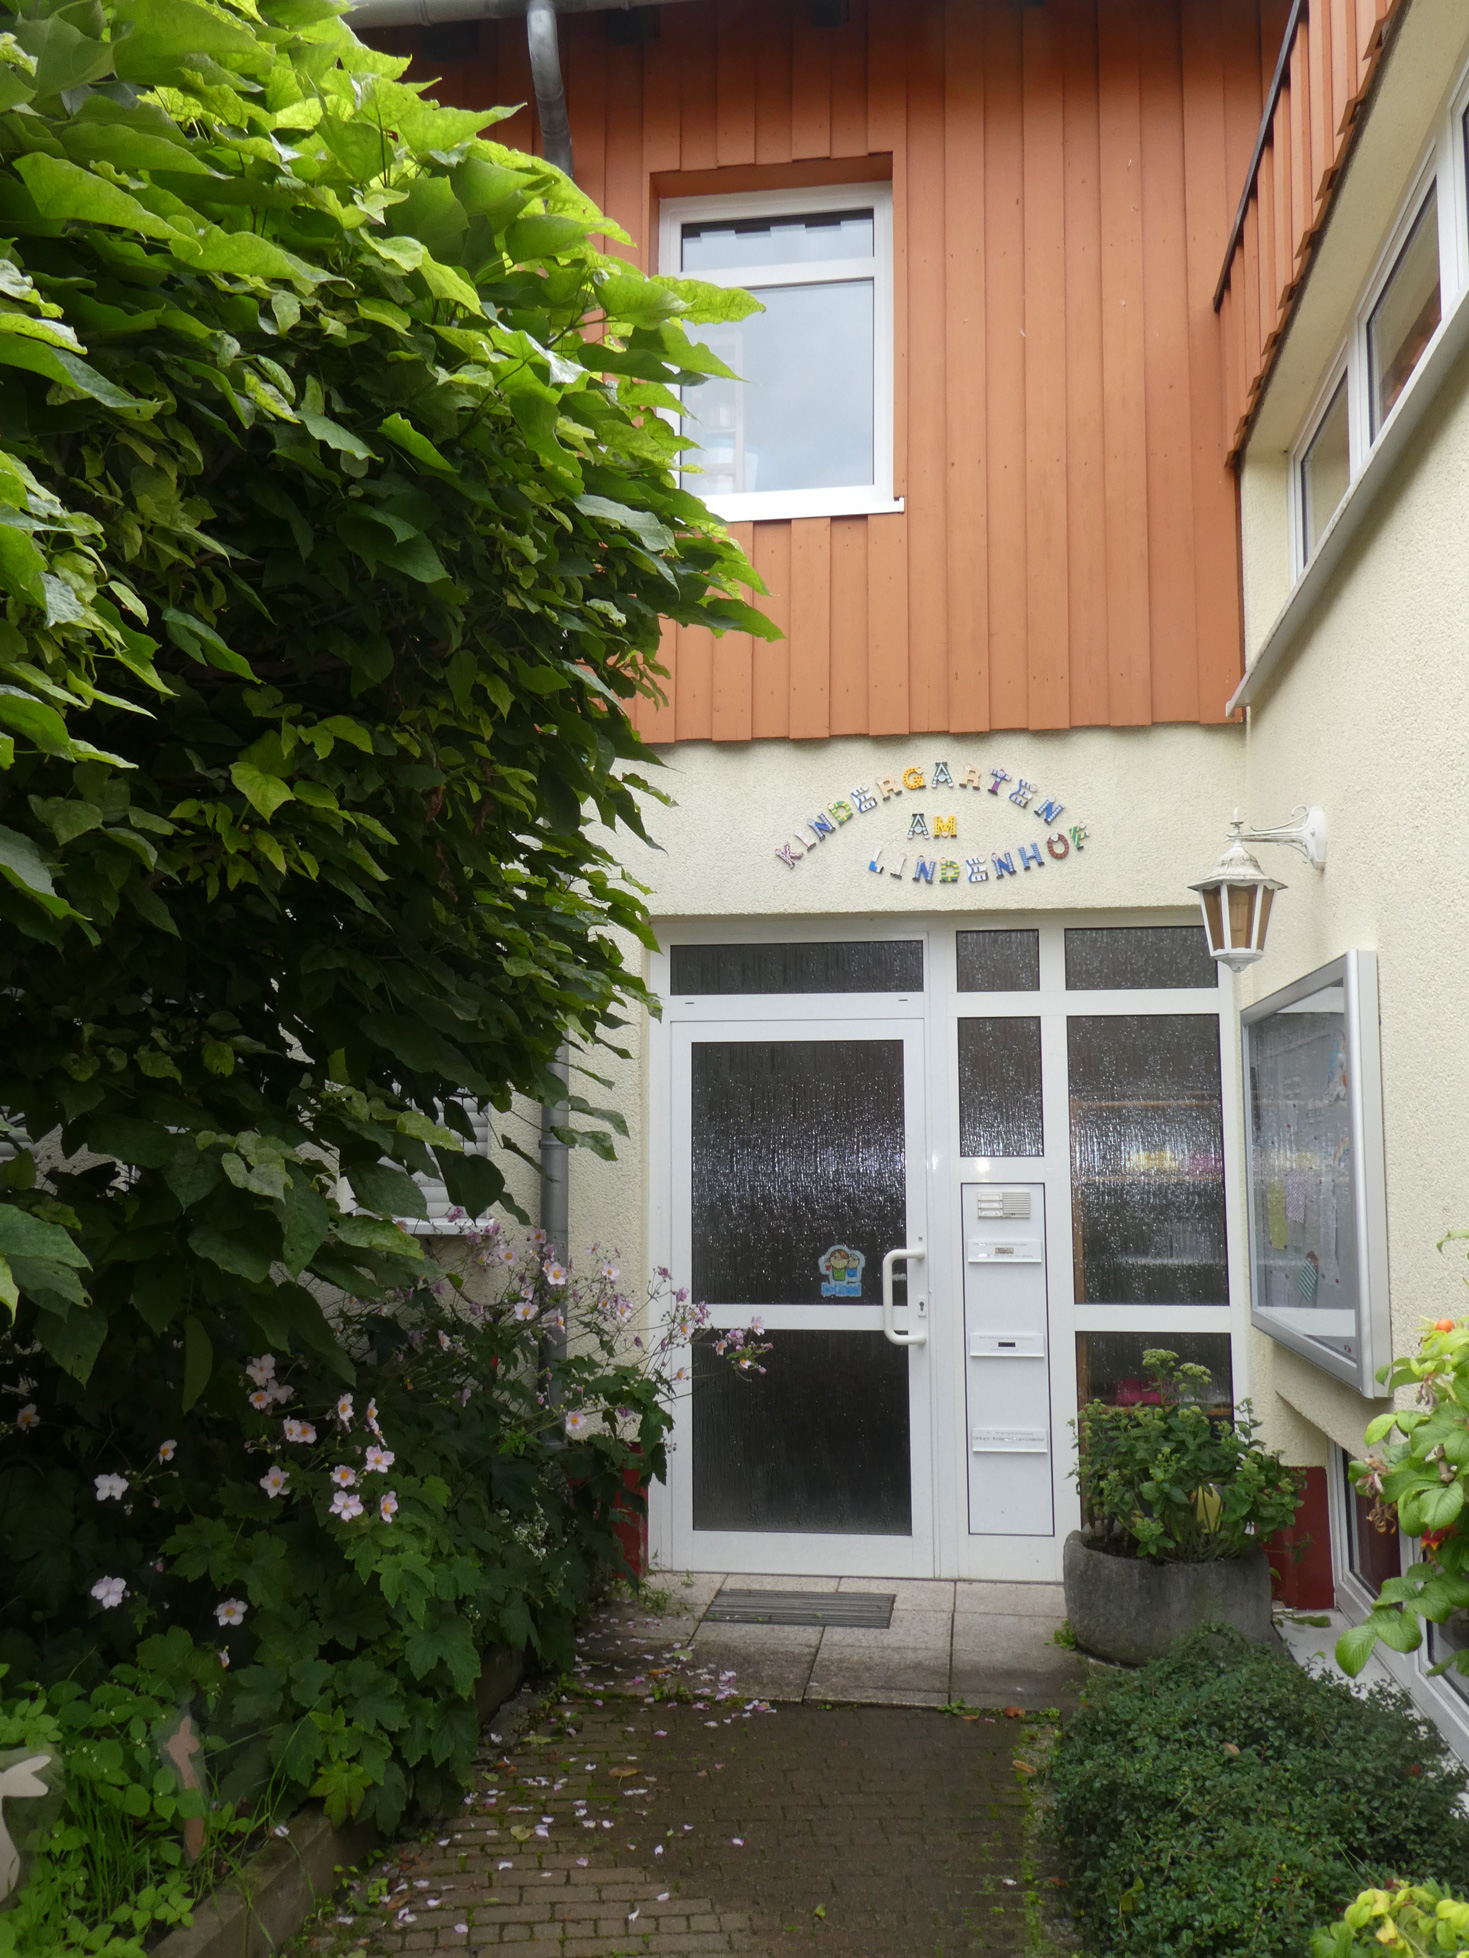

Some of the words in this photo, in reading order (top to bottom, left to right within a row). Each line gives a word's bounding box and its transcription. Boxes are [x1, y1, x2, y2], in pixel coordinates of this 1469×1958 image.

[774, 762, 1063, 869] KINDERGARTEN
[907, 813, 957, 839] AM
[868, 822, 1089, 884] LINDENHOF
